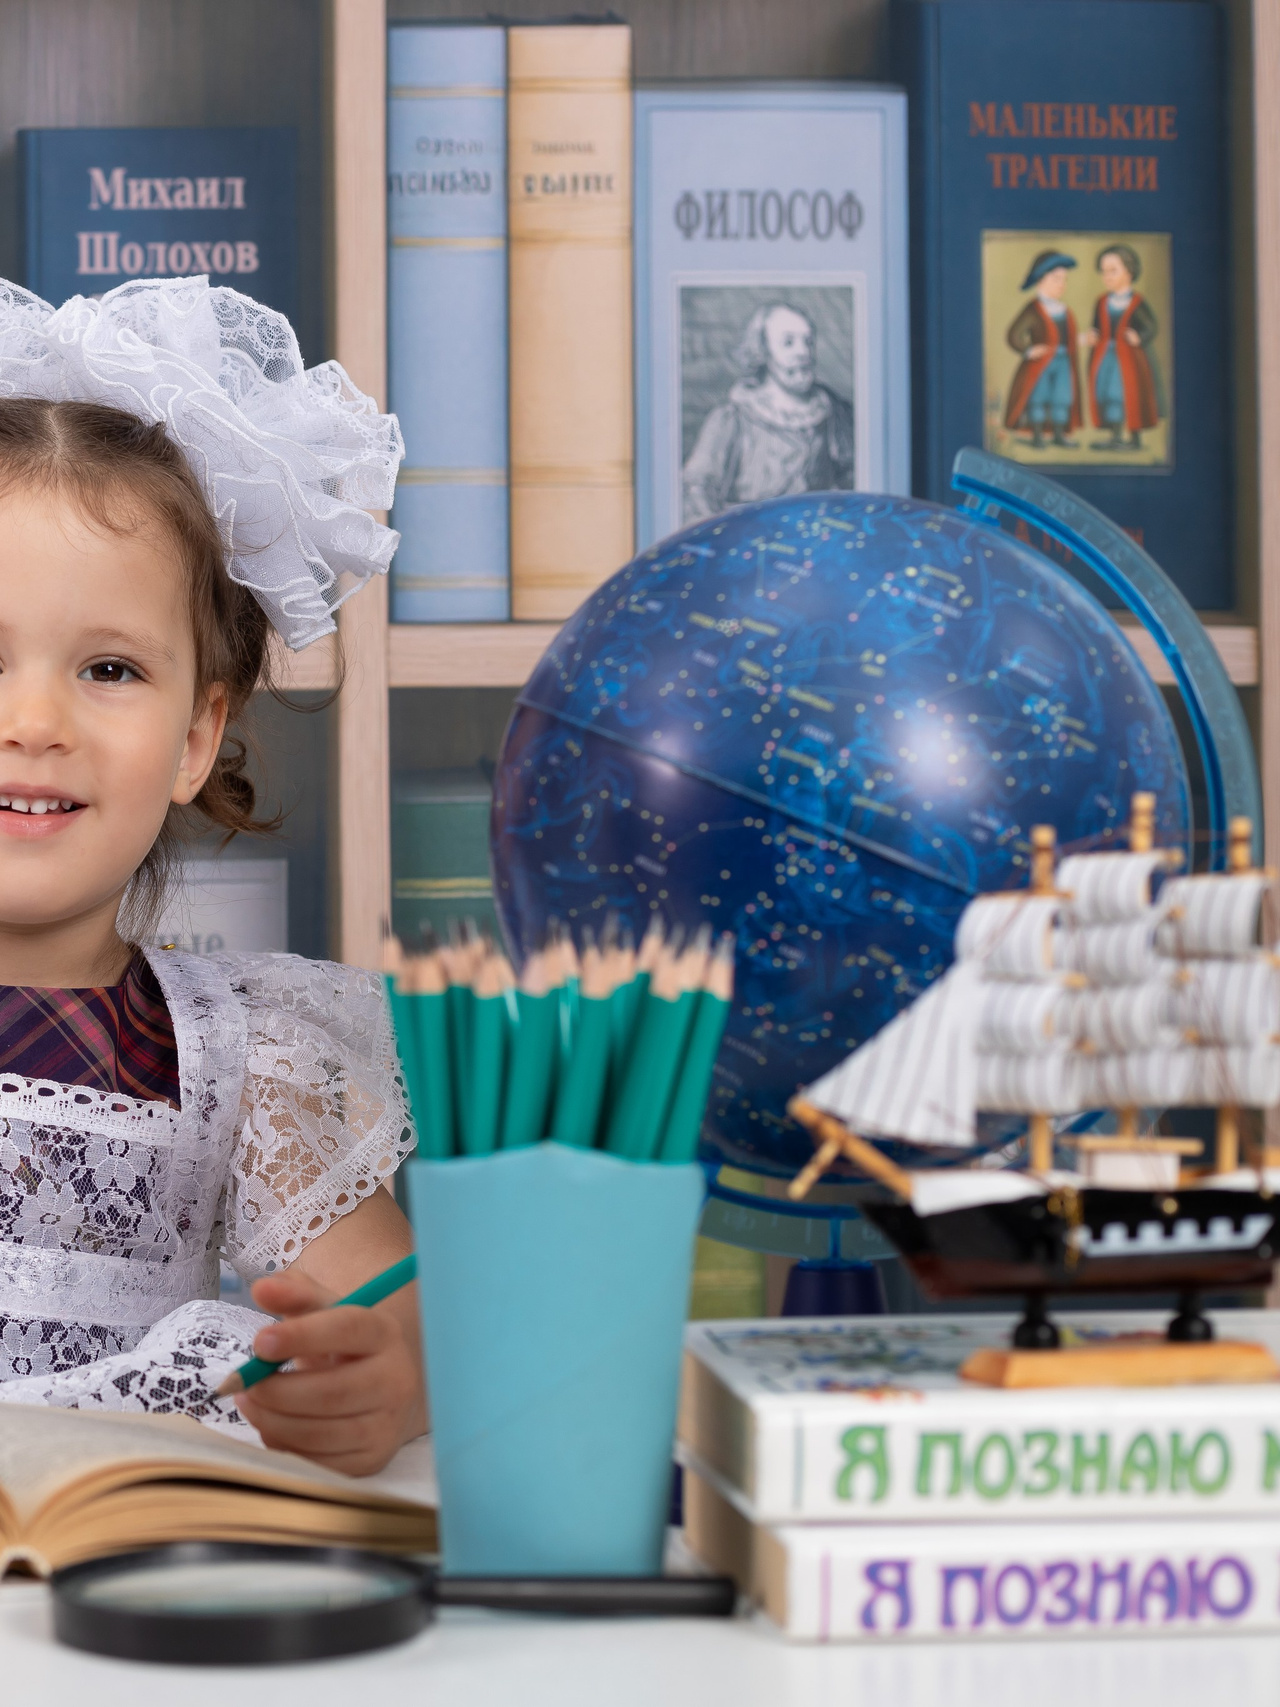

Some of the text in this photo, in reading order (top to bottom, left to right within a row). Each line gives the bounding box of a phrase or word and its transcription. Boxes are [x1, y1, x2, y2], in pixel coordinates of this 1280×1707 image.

[969, 101, 1179, 141] МАЛЕНЬКИЕ
[87, 166, 248, 211] Михаил
[985, 152, 1160, 196] ТРАГЕДИИ
[673, 188, 866, 242] ФИЛОСОФ
[76, 231, 260, 276] Шолохов
[834, 1423, 891, 1504] Я
[913, 1425, 1233, 1501] ПОЗНАЮ
[858, 1554, 1255, 1633] Я ПОЗНАЮ
